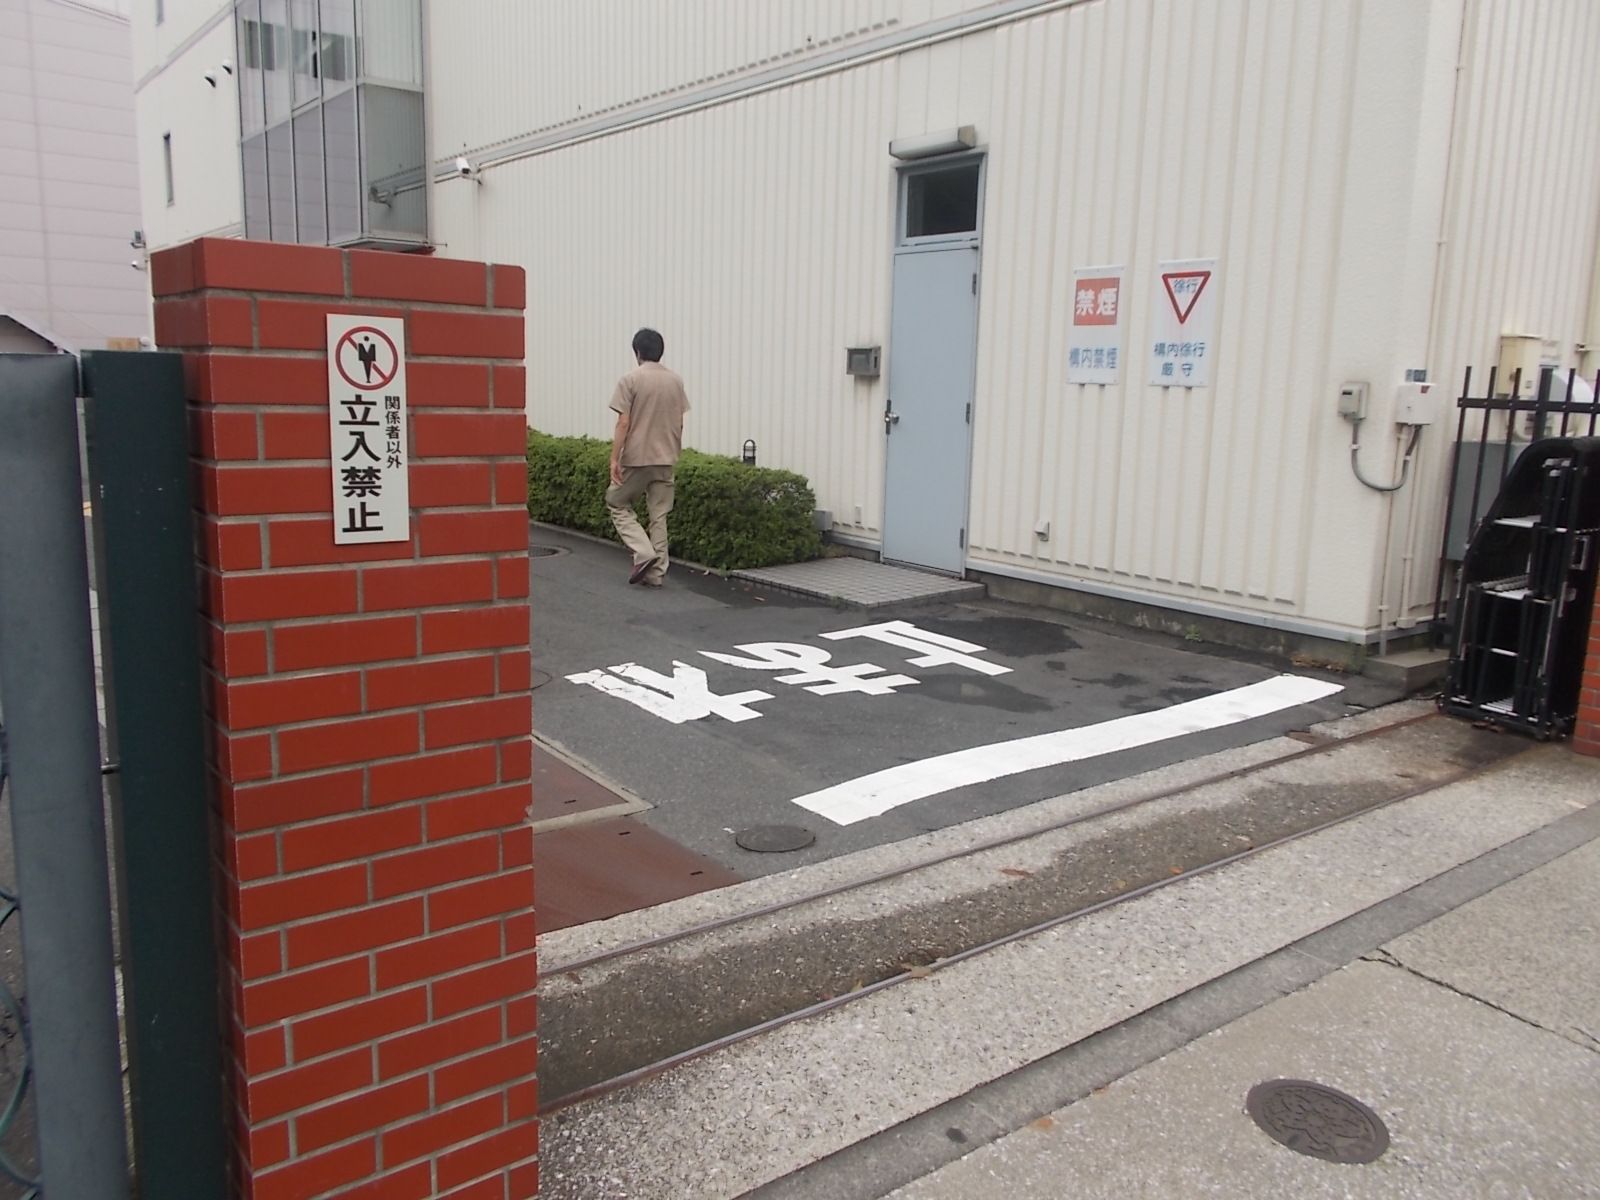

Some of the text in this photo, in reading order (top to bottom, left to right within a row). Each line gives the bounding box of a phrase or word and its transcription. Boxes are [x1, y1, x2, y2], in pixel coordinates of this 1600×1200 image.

[1173, 278, 1198, 294] 徐行
[1075, 287, 1118, 316] 禁煙
[1069, 347, 1118, 369] 構内禁煙
[1153, 341, 1206, 358] 構内徐行
[384, 395, 402, 469] 関係者以外
[339, 394, 383, 533] 立入禁止
